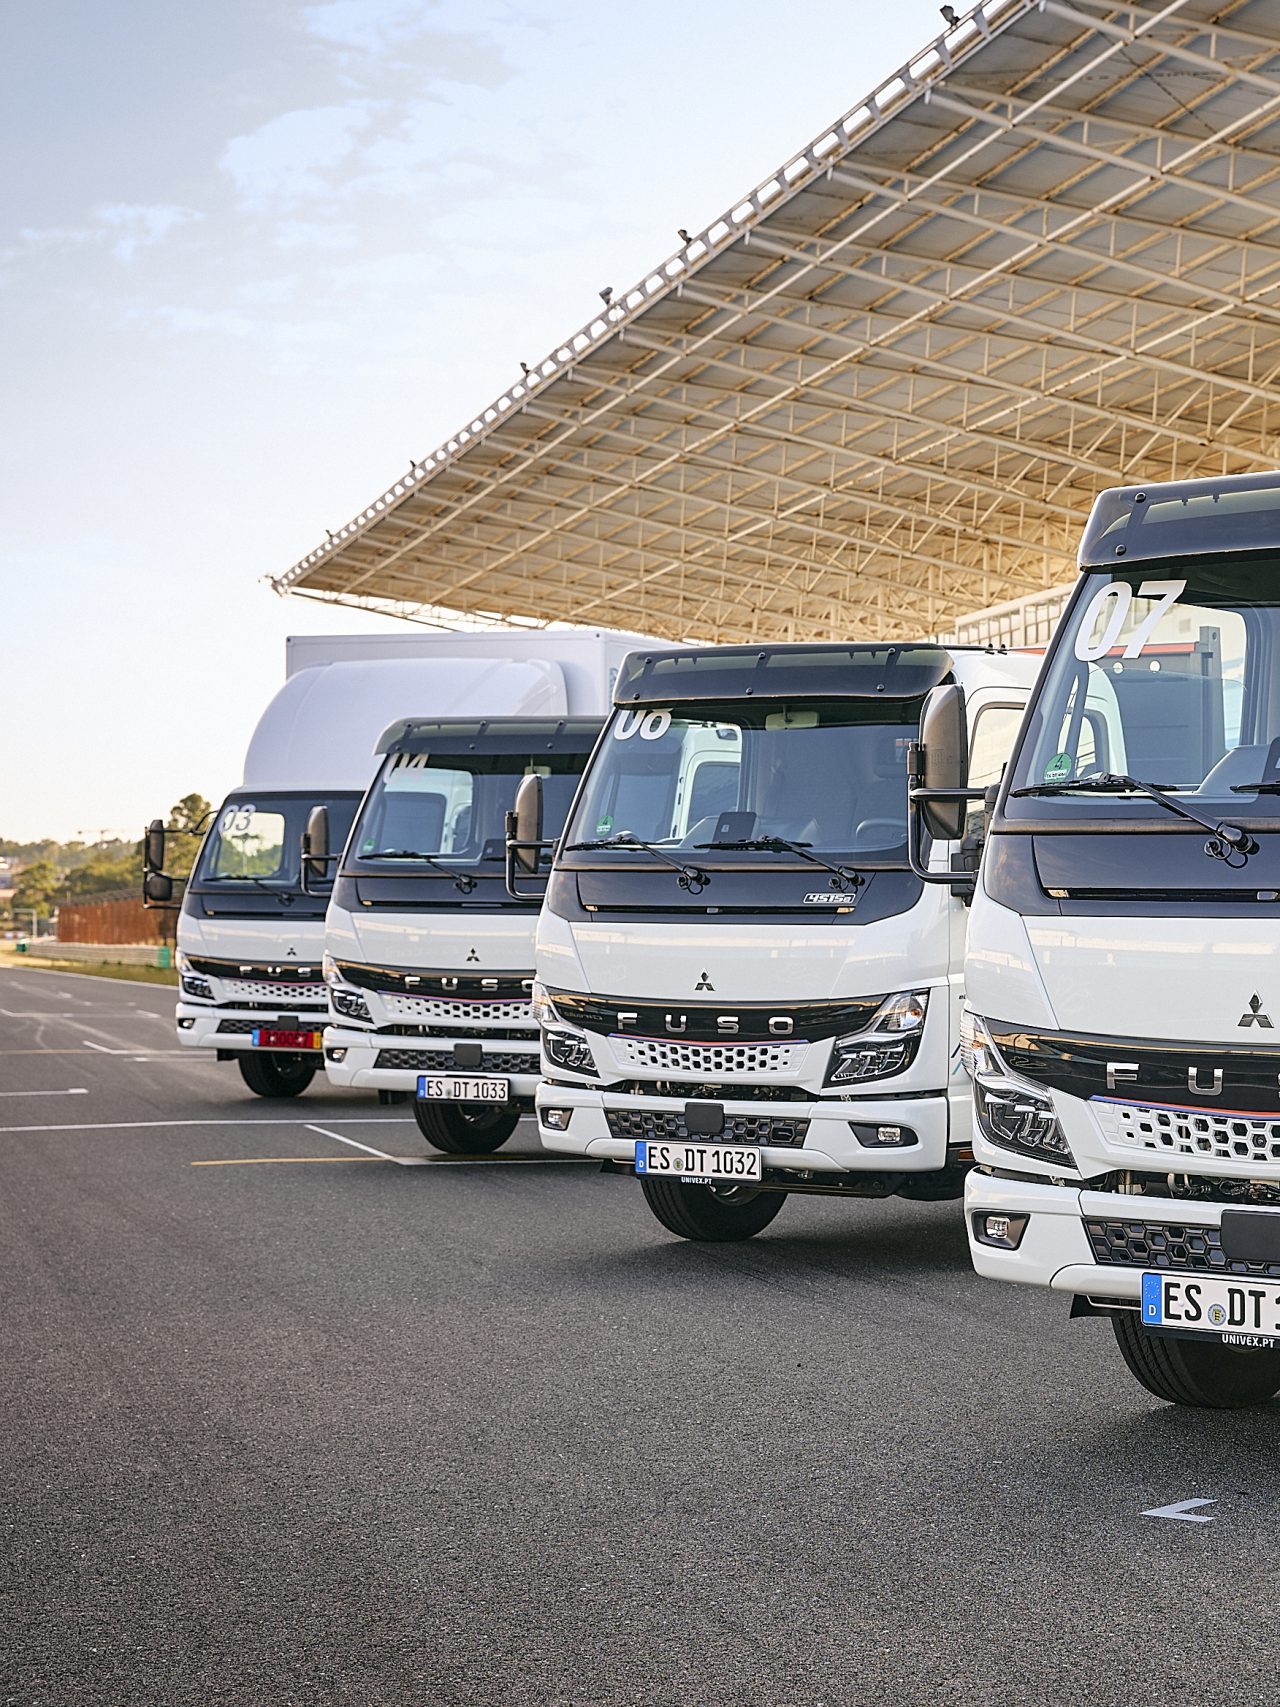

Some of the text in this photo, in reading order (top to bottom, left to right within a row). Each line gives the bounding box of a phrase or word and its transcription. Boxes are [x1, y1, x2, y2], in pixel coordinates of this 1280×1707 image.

[1074, 579, 1188, 662] 07
[217, 803, 256, 833] 03
[239, 966, 312, 978] FUS
[617, 1012, 794, 1035] FUSO
[427, 1080, 443, 1097] ES
[453, 1081, 470, 1098] DT
[473, 1082, 506, 1099] 1033
[638, 1160, 645, 1168] D
[648, 1145, 757, 1176] ES DT 1032
[680, 1176, 713, 1185] UNIVEX.PT
[1148, 1304, 1157, 1316] D
[1164, 1281, 1202, 1322] ES
[1227, 1287, 1266, 1329] DT
[1221, 1333, 1275, 1348] UNIVEX.PT
